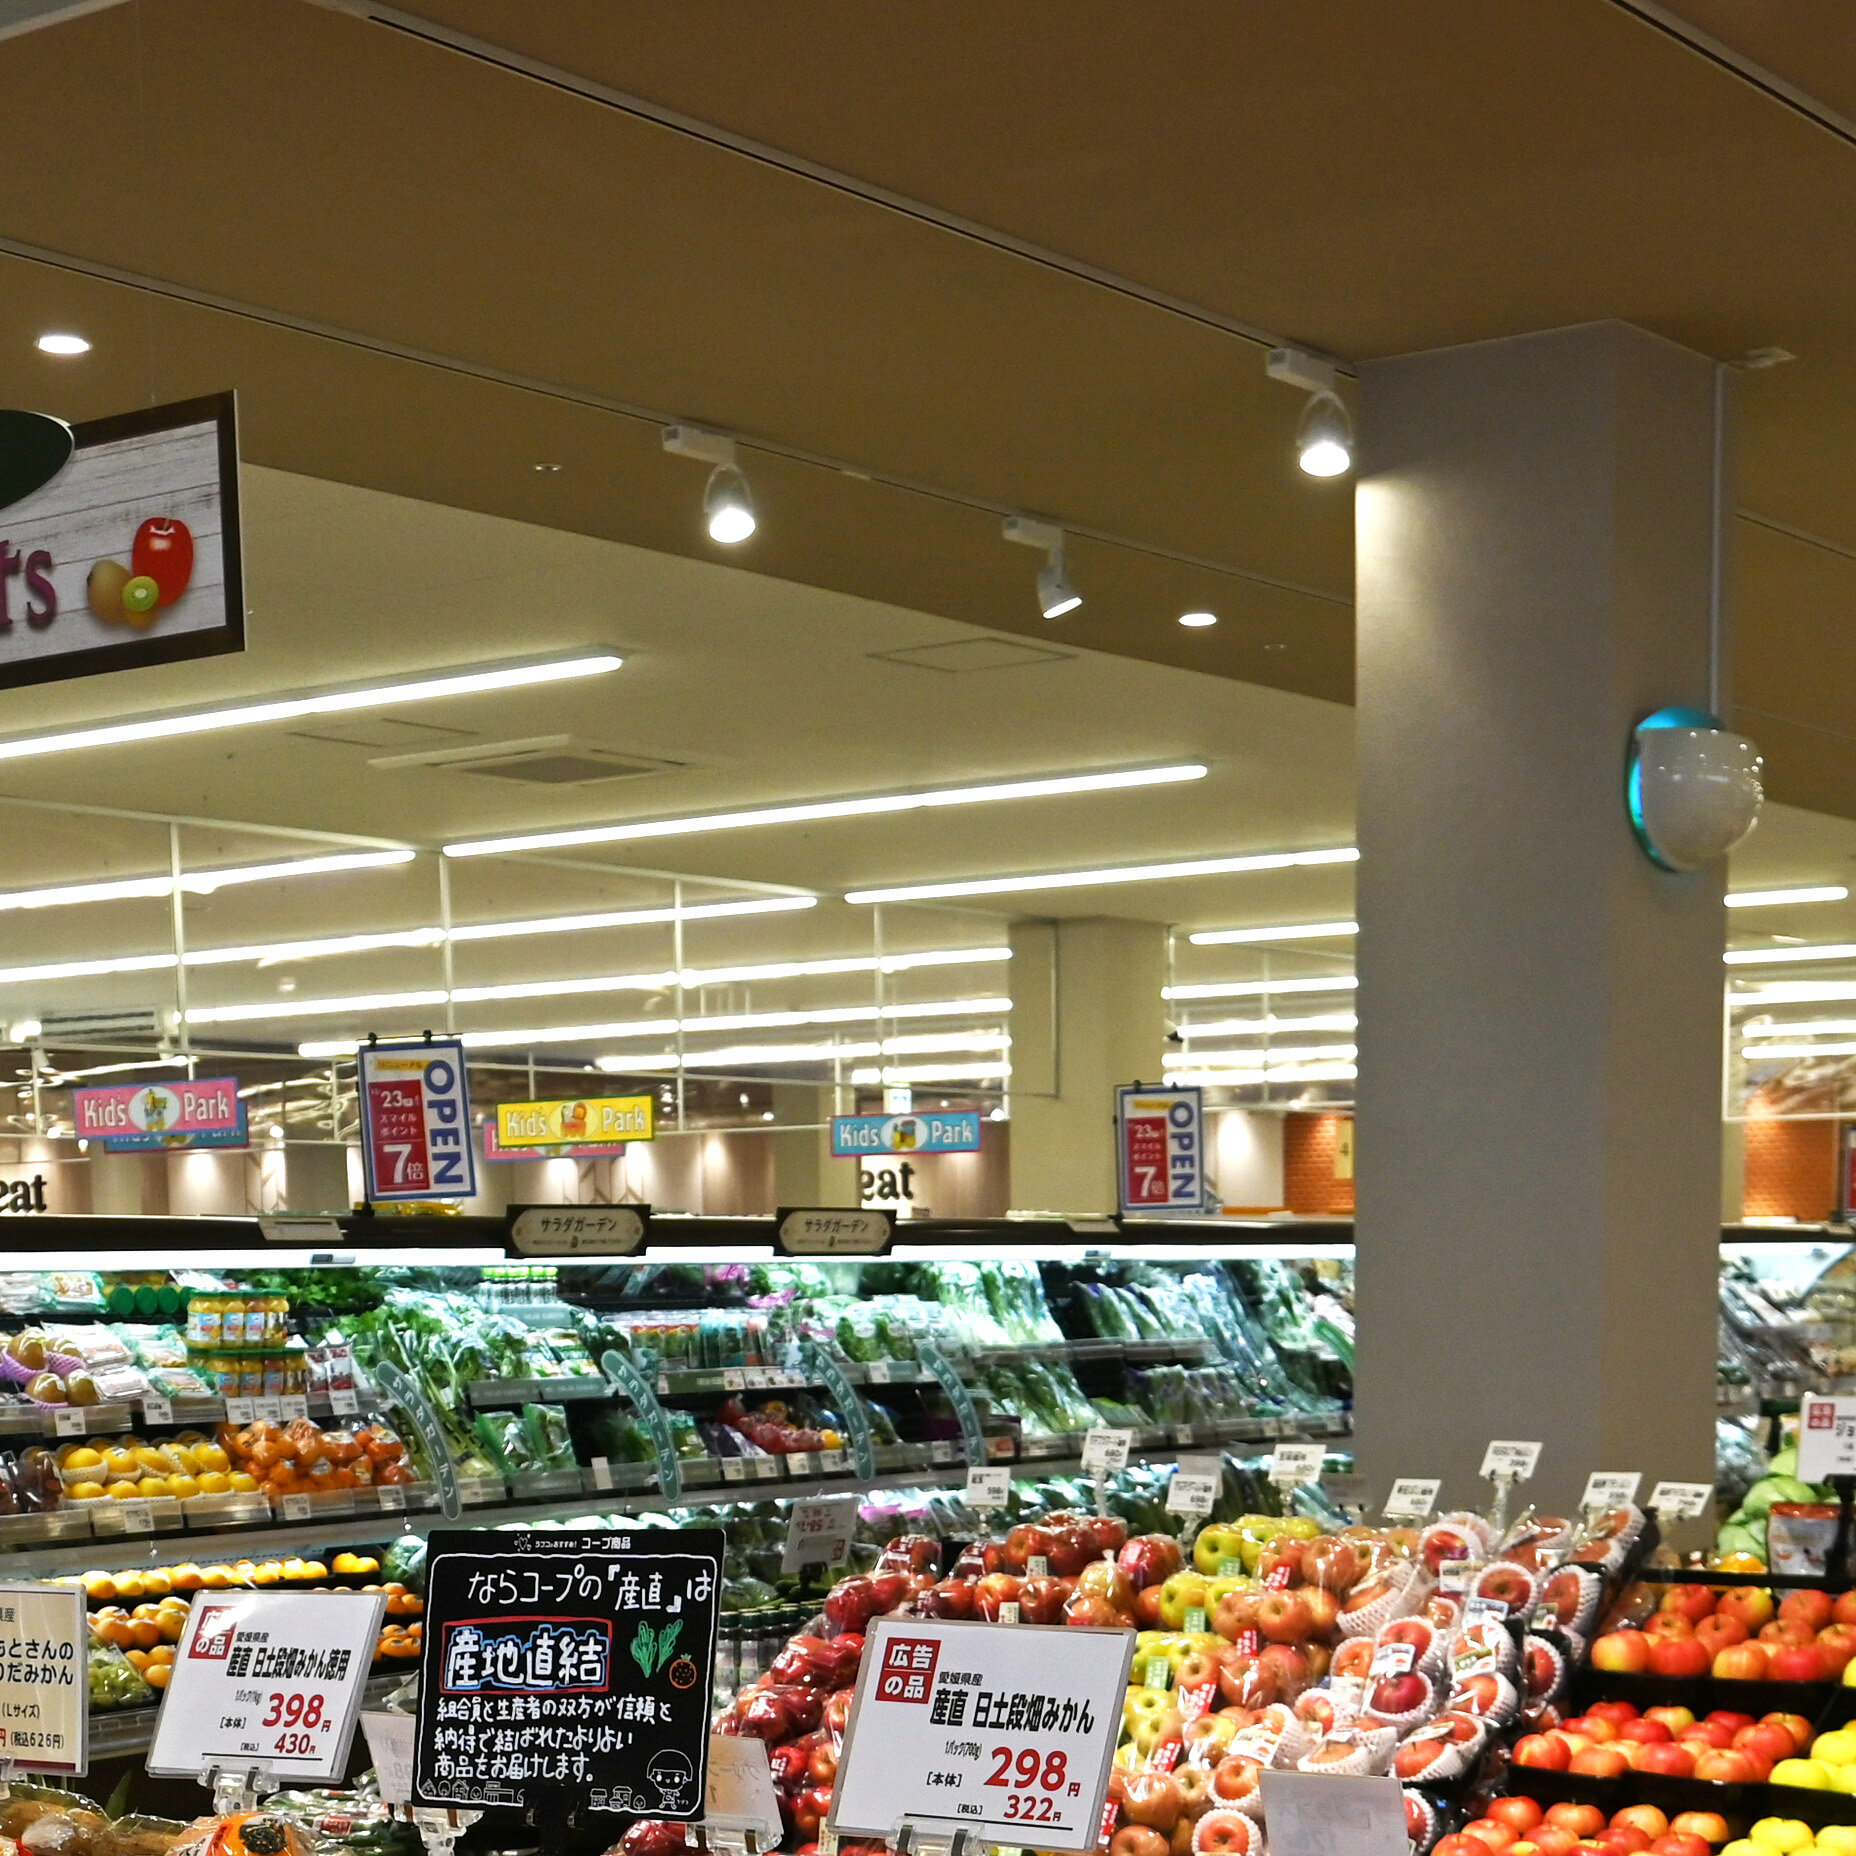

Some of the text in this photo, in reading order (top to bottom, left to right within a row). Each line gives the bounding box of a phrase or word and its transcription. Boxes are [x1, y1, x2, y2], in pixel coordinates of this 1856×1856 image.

[183, 1090, 229, 1121] Park
[379, 1113, 416, 1123] スマイル
[380, 1127, 417, 1136] ポイント
[424, 1059, 463, 1184] OPEN
[602, 1106, 646, 1132] Park
[931, 1120, 973, 1143] Park
[1169, 1101, 1195, 1198] OPEN
[860, 1161, 915, 1201] eat
[541, 1217, 617, 1232] サラダガーデン
[582, 1537, 631, 1549] コープ商品
[196, 1636, 226, 1655] の品
[889, 1643, 934, 1669] 広告
[445, 1630, 608, 1688] 産地直結
[883, 1674, 927, 1699] の品
[938, 1671, 983, 1686] 愛媛県産
[436, 1696, 673, 1725] 組合員と生産者の双方が信頼と
[930, 1690, 1094, 1734] 産直 日土段畑みかん
[434, 1726, 633, 1753] 納得で結ばれたよりよい
[434, 1755, 595, 1783] 商品をお届けします。
